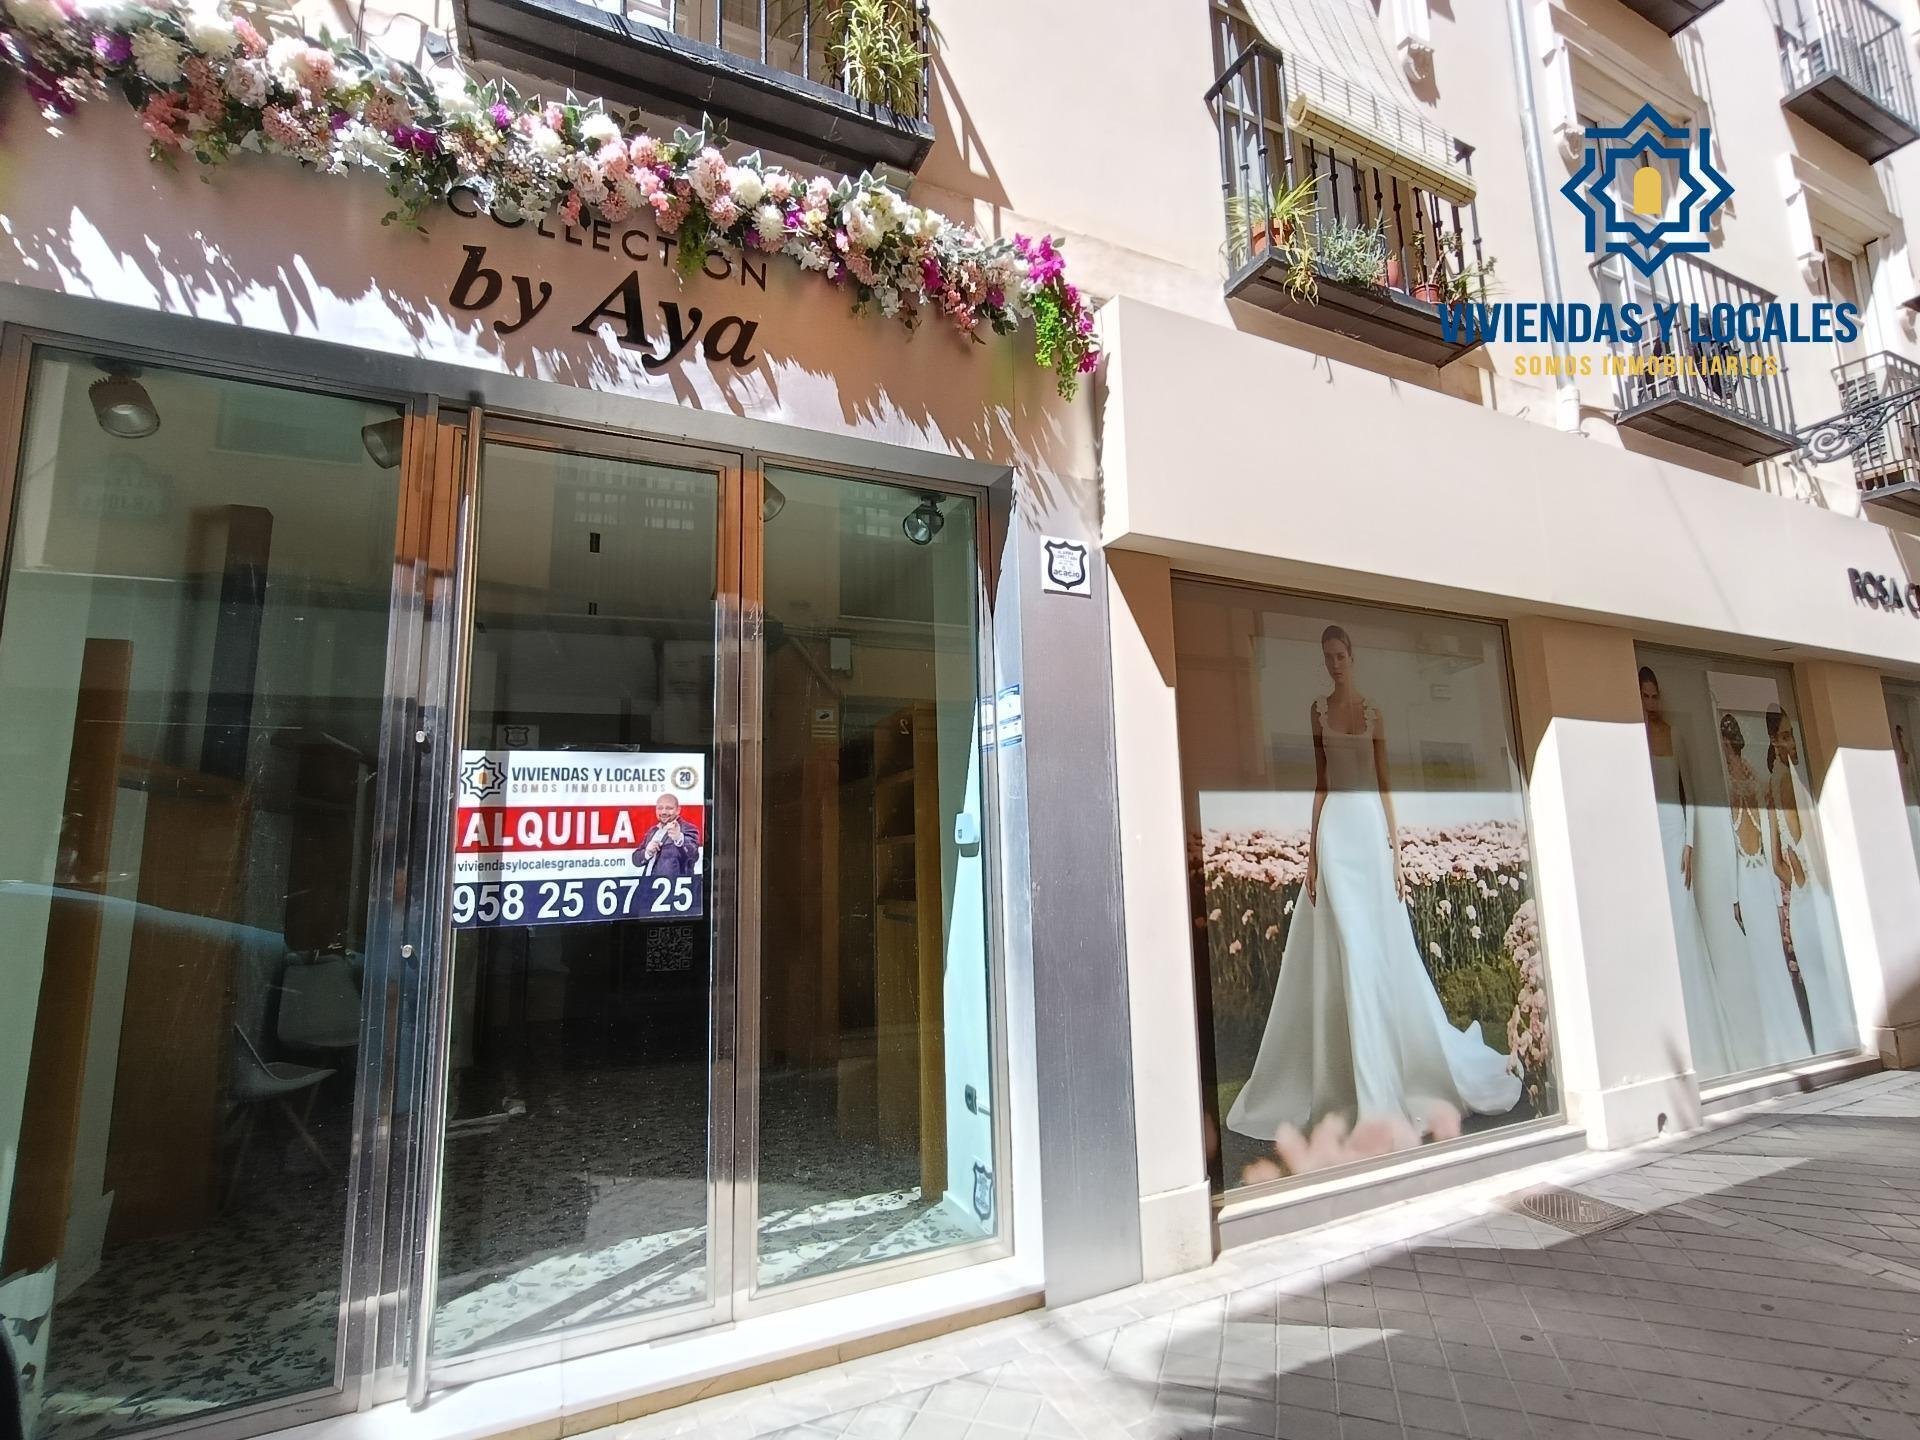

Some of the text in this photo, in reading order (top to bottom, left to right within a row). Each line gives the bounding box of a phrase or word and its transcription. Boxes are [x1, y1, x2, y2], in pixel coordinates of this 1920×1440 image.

[447, 185, 767, 292] COLLECTON
[448, 245, 760, 368] by Aya
[1848, 567, 1904, 611] ROSA
[511, 767, 666, 782] VIVIENDAS Y LOCALES
[512, 783, 666, 793] SOMOS INMOBILIARIOS
[679, 771, 691, 782] 20
[462, 810, 636, 849] ALQUILA
[457, 857, 626, 875] viviendasylocalesgranada.com
[452, 876, 693, 924] 958 25 67 25
